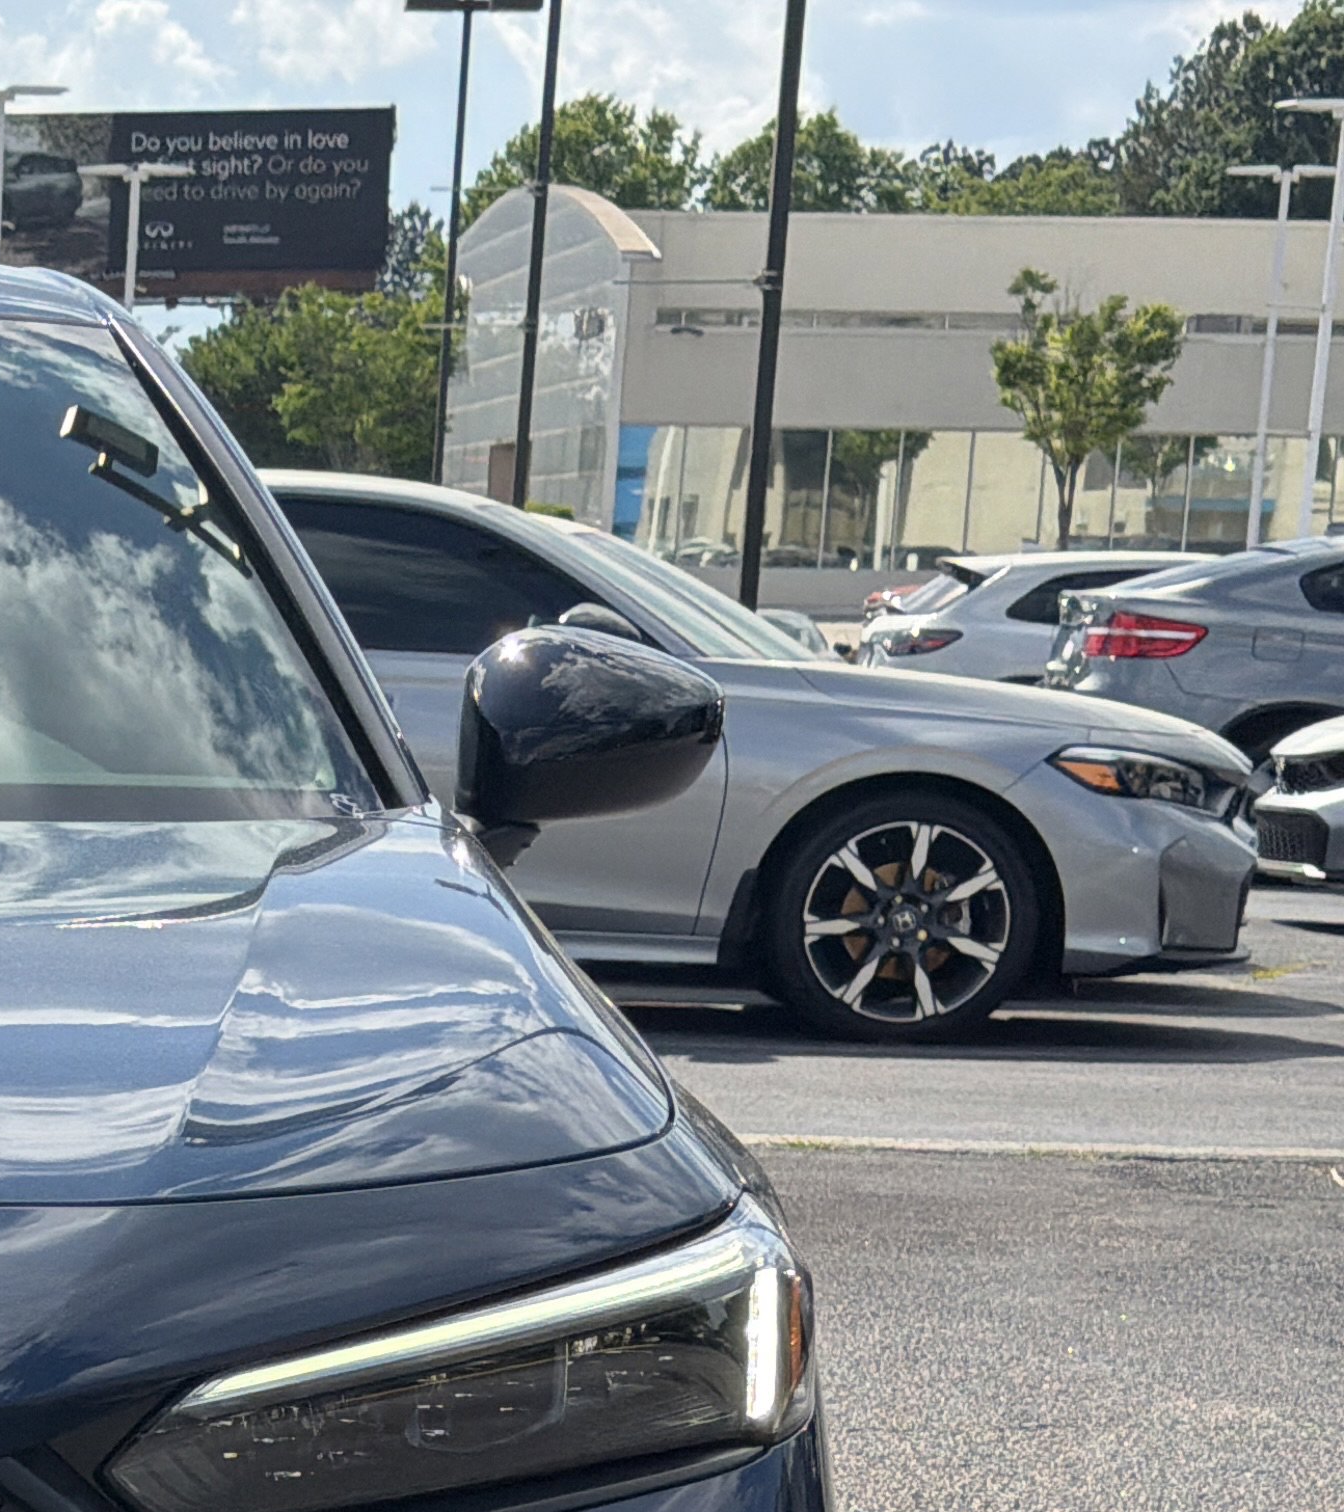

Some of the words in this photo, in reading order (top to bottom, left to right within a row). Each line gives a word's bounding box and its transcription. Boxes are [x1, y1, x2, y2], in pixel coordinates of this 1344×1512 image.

[131, 131, 161, 153] Do
[166, 136, 203, 156] you
[208, 131, 279, 151] believe
[284, 130, 302, 150] in
[307, 129, 349, 150] love
[201, 154, 263, 181] sight?
[267, 154, 294, 175] Or
[299, 155, 327, 175] do
[332, 158, 369, 177] you
[141, 182, 178, 201] eed
[184, 183, 204, 201] to
[210, 180, 260, 200] drive
[265, 180, 289, 203] by
[294, 178, 361, 204] again?
